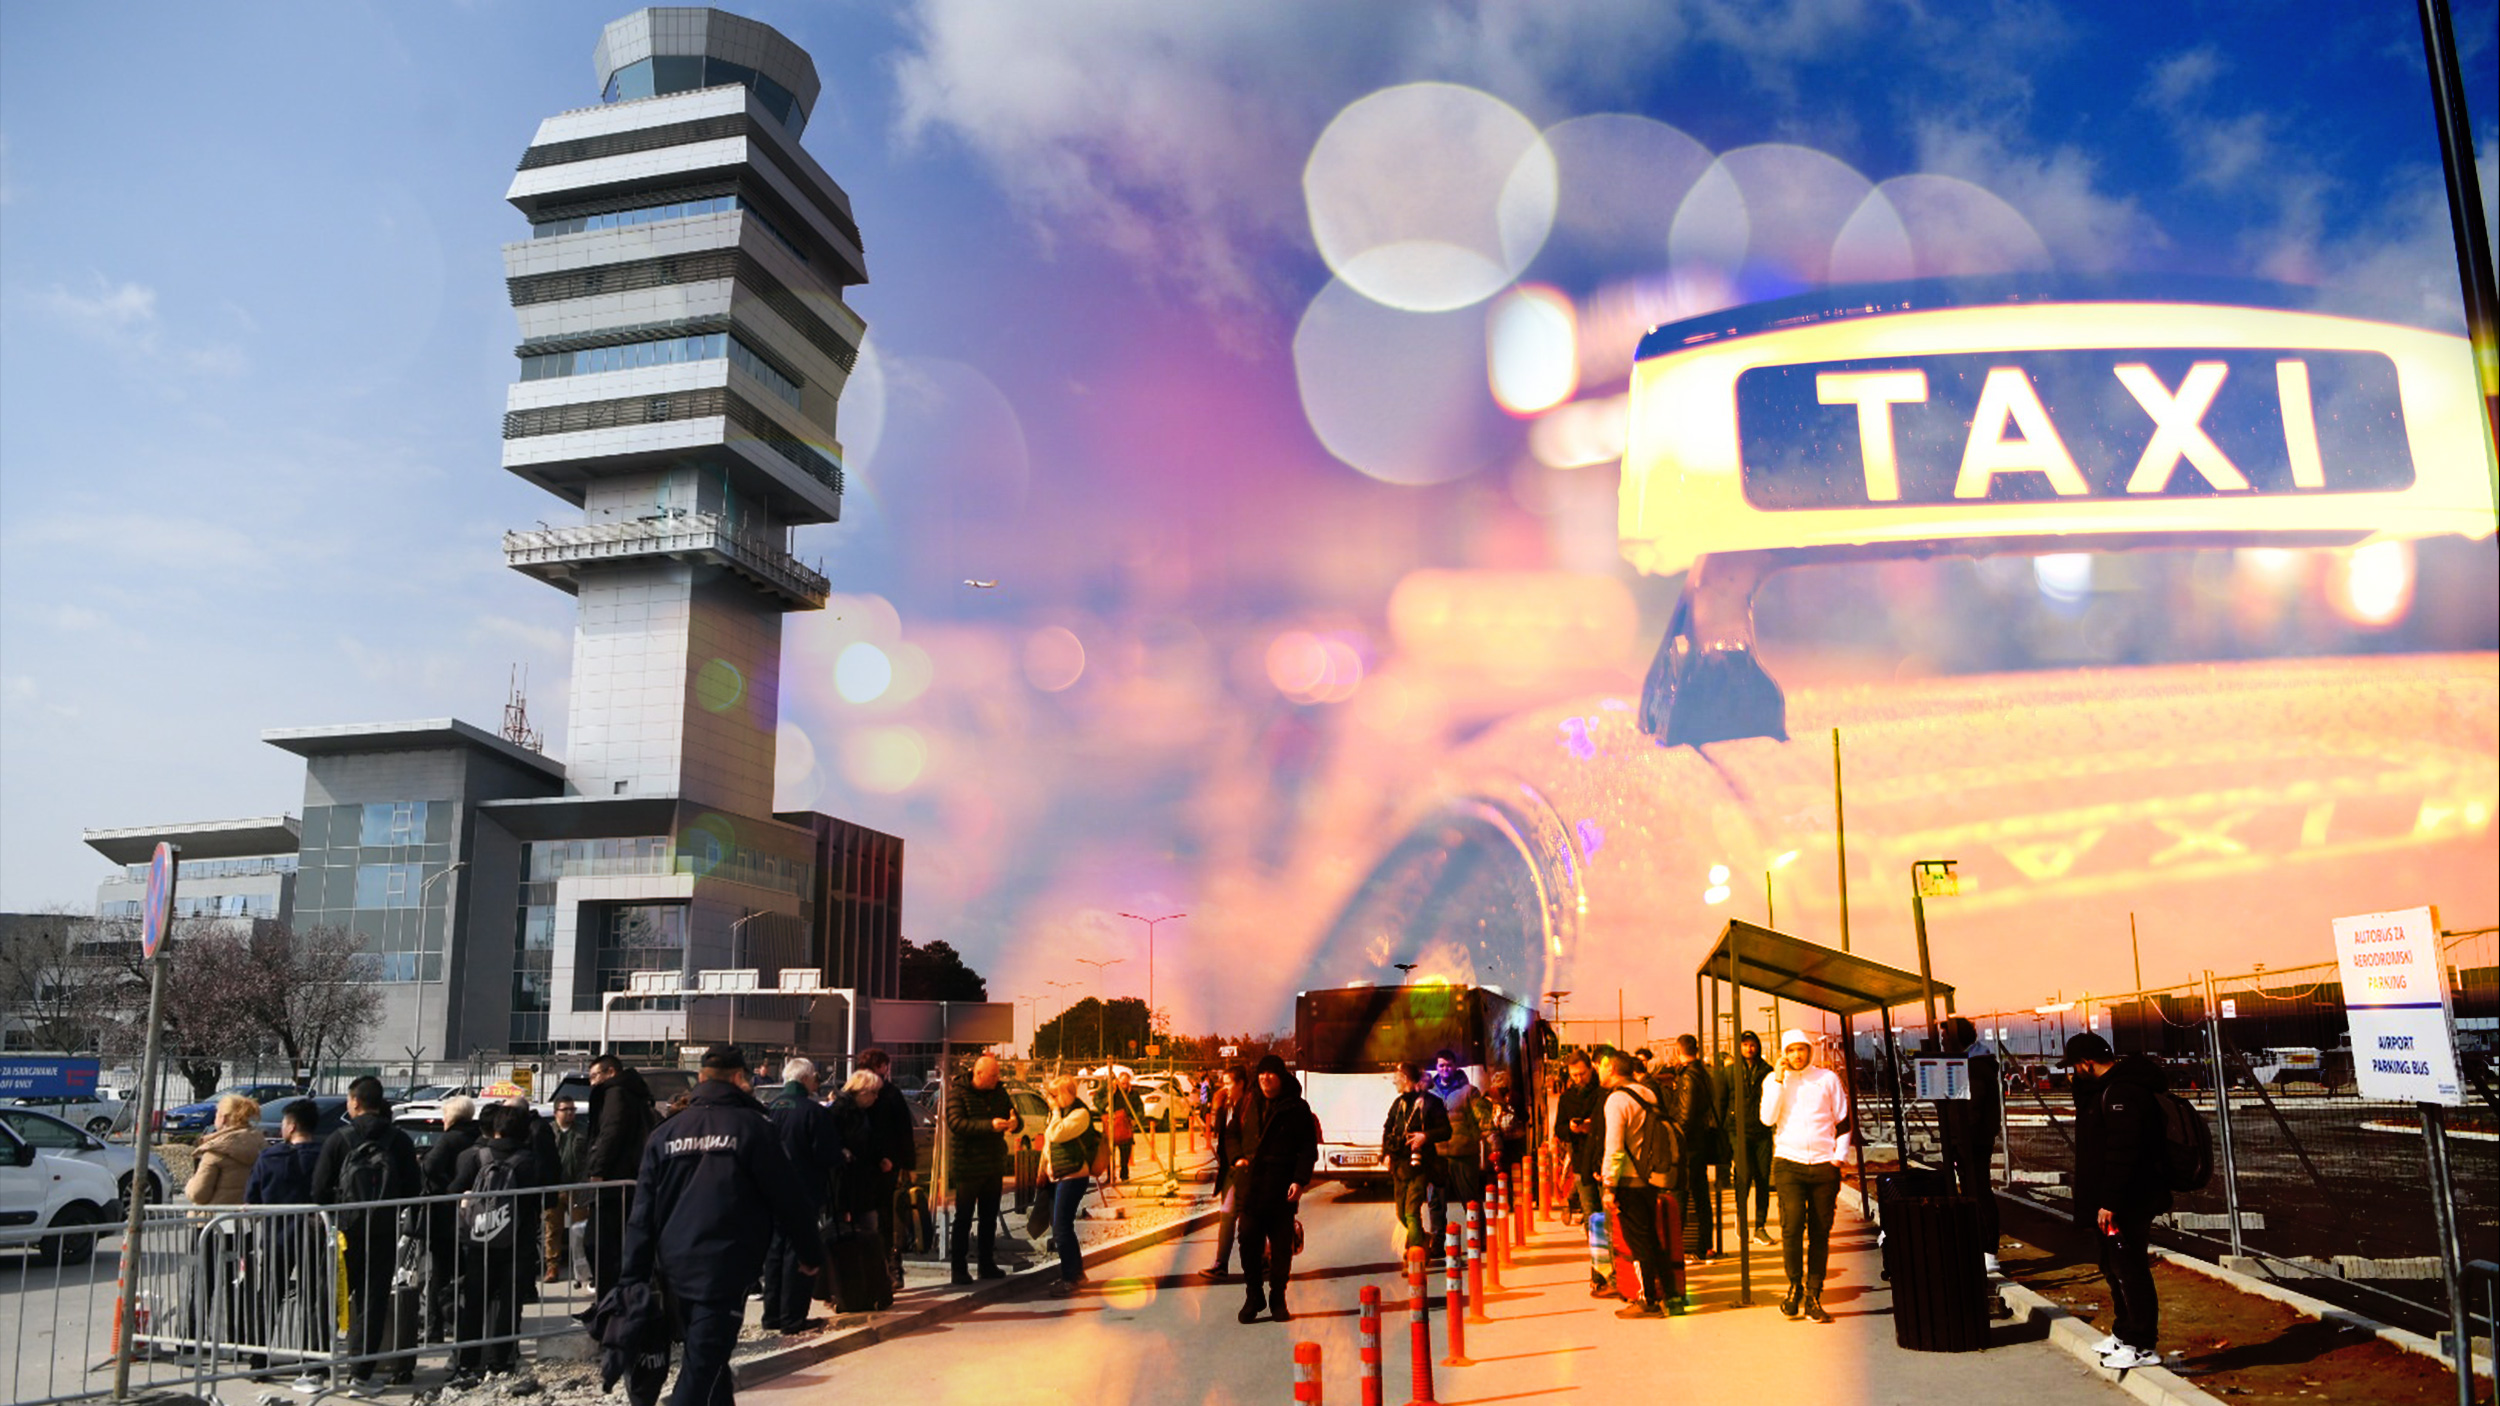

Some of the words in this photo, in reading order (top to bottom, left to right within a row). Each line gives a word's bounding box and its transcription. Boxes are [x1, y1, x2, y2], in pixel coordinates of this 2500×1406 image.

[1816, 361, 2326, 501] TAXI
[2354, 927, 2393, 945] AUTOBUS
[2394, 926, 2406, 941] ZA
[2353, 949, 2413, 968] AERODROMSKI
[2368, 974, 2407, 989] PARKING
[2378, 1036, 2415, 1050] AIRPORT
[2372, 1059, 2411, 1074] PARKING
[2412, 1061, 2430, 1076] BUS
[664, 1134, 737, 1154] ПОЛИЦИЈА
[475, 1203, 511, 1233] NIKE
